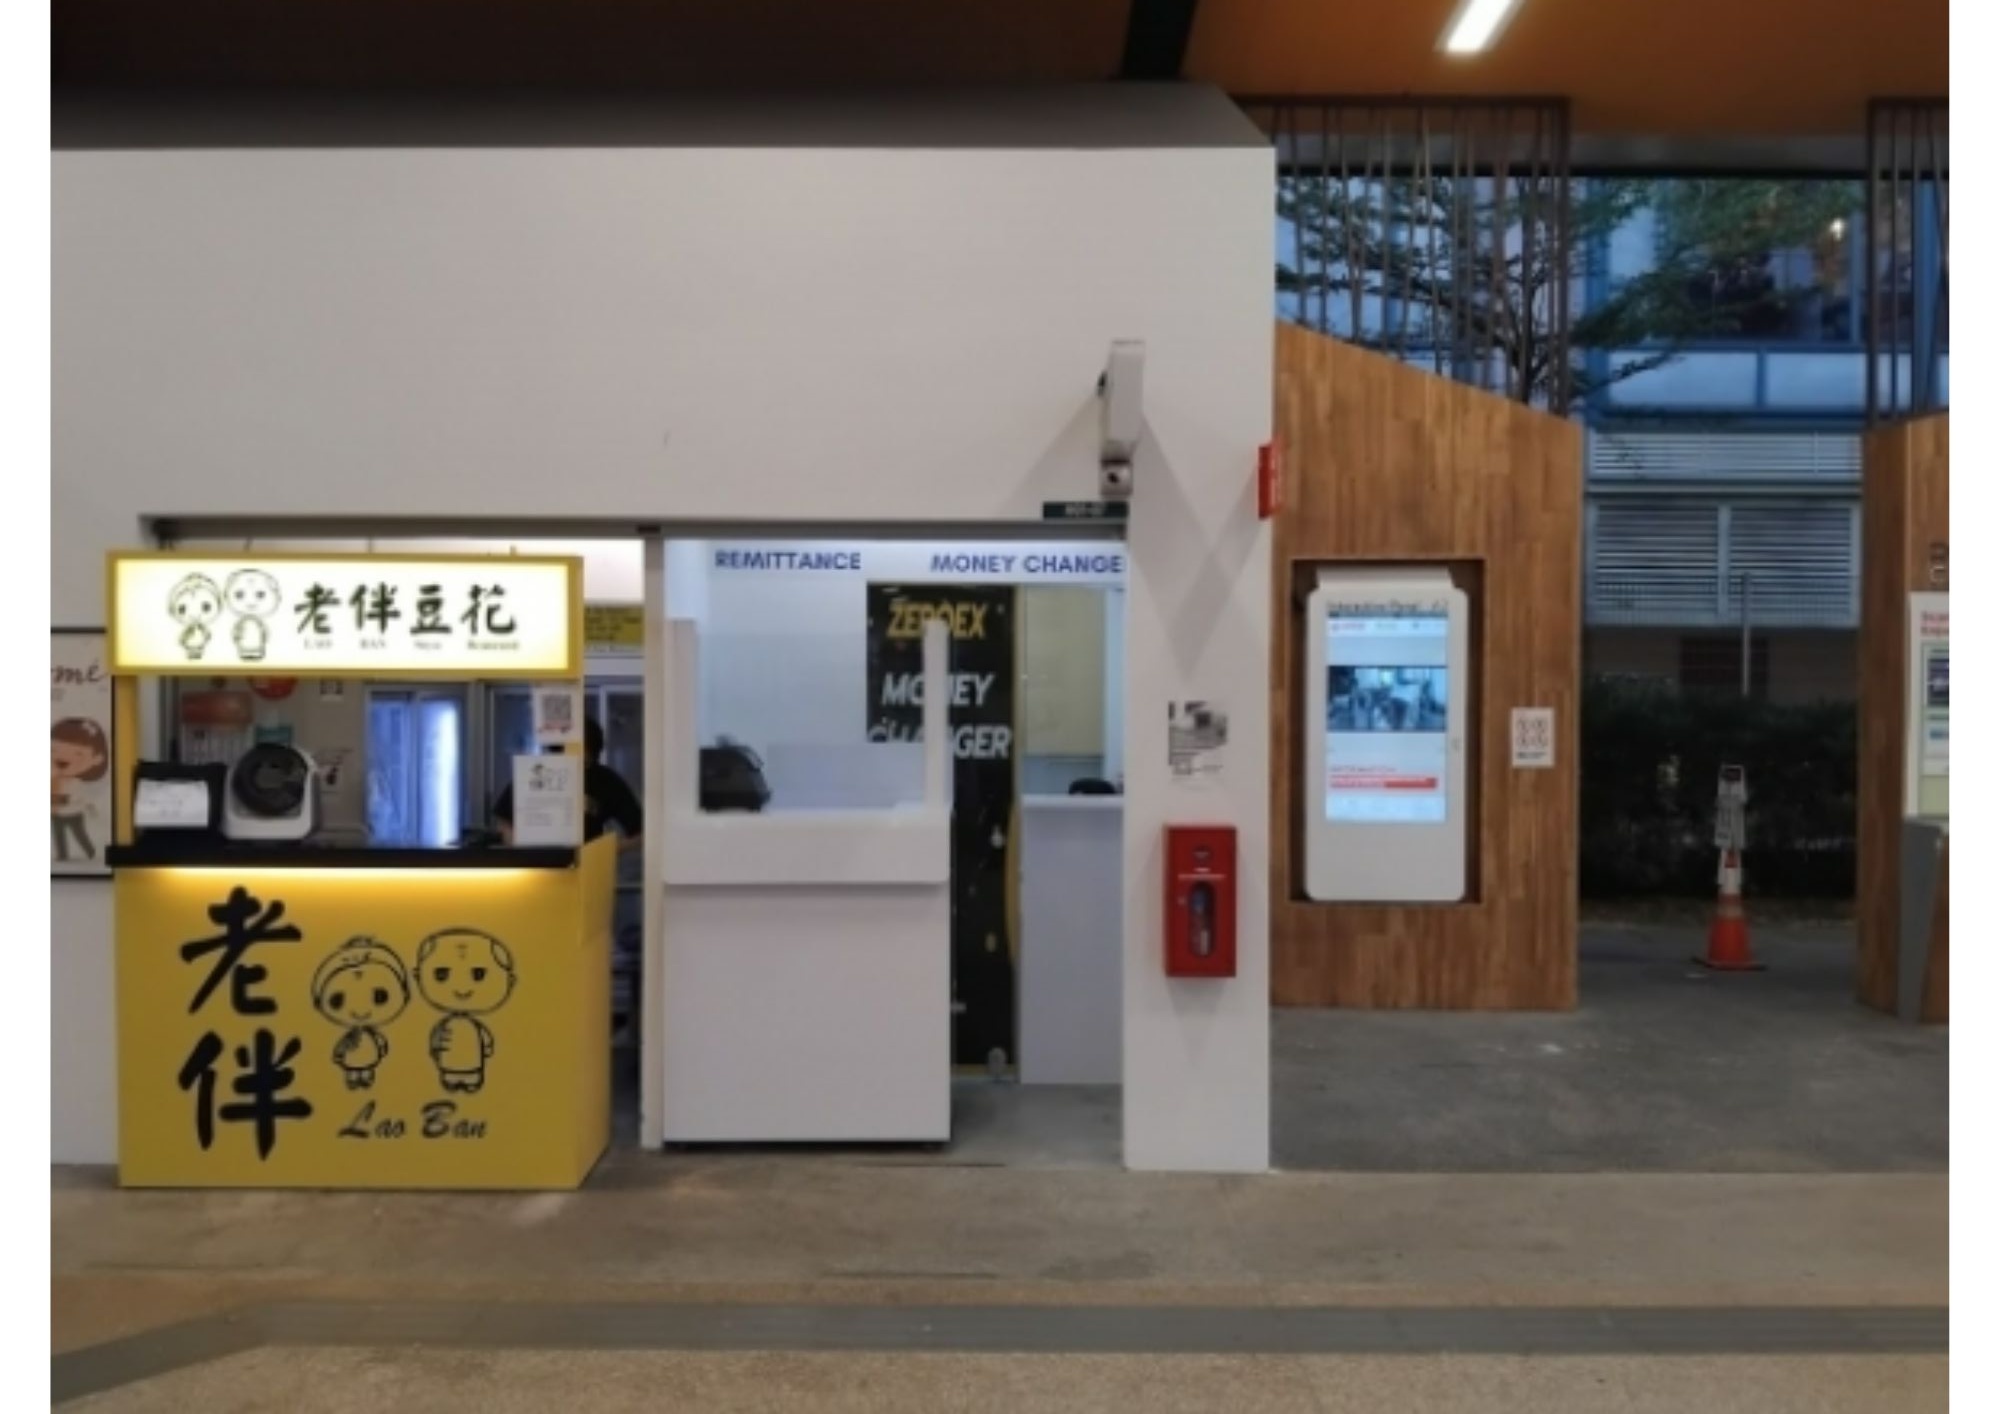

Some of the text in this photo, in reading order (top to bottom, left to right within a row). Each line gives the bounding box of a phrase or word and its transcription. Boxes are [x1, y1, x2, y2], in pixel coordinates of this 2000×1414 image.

[714, 551, 862, 571] REMITTANCE
[931, 554, 1016, 573] MONEY
[294, 581, 517, 635] 老伴豆花
[882, 672, 994, 706] MOEY
[179, 887, 313, 1161] 老伴
[338, 1101, 488, 1140] Lao Ban
